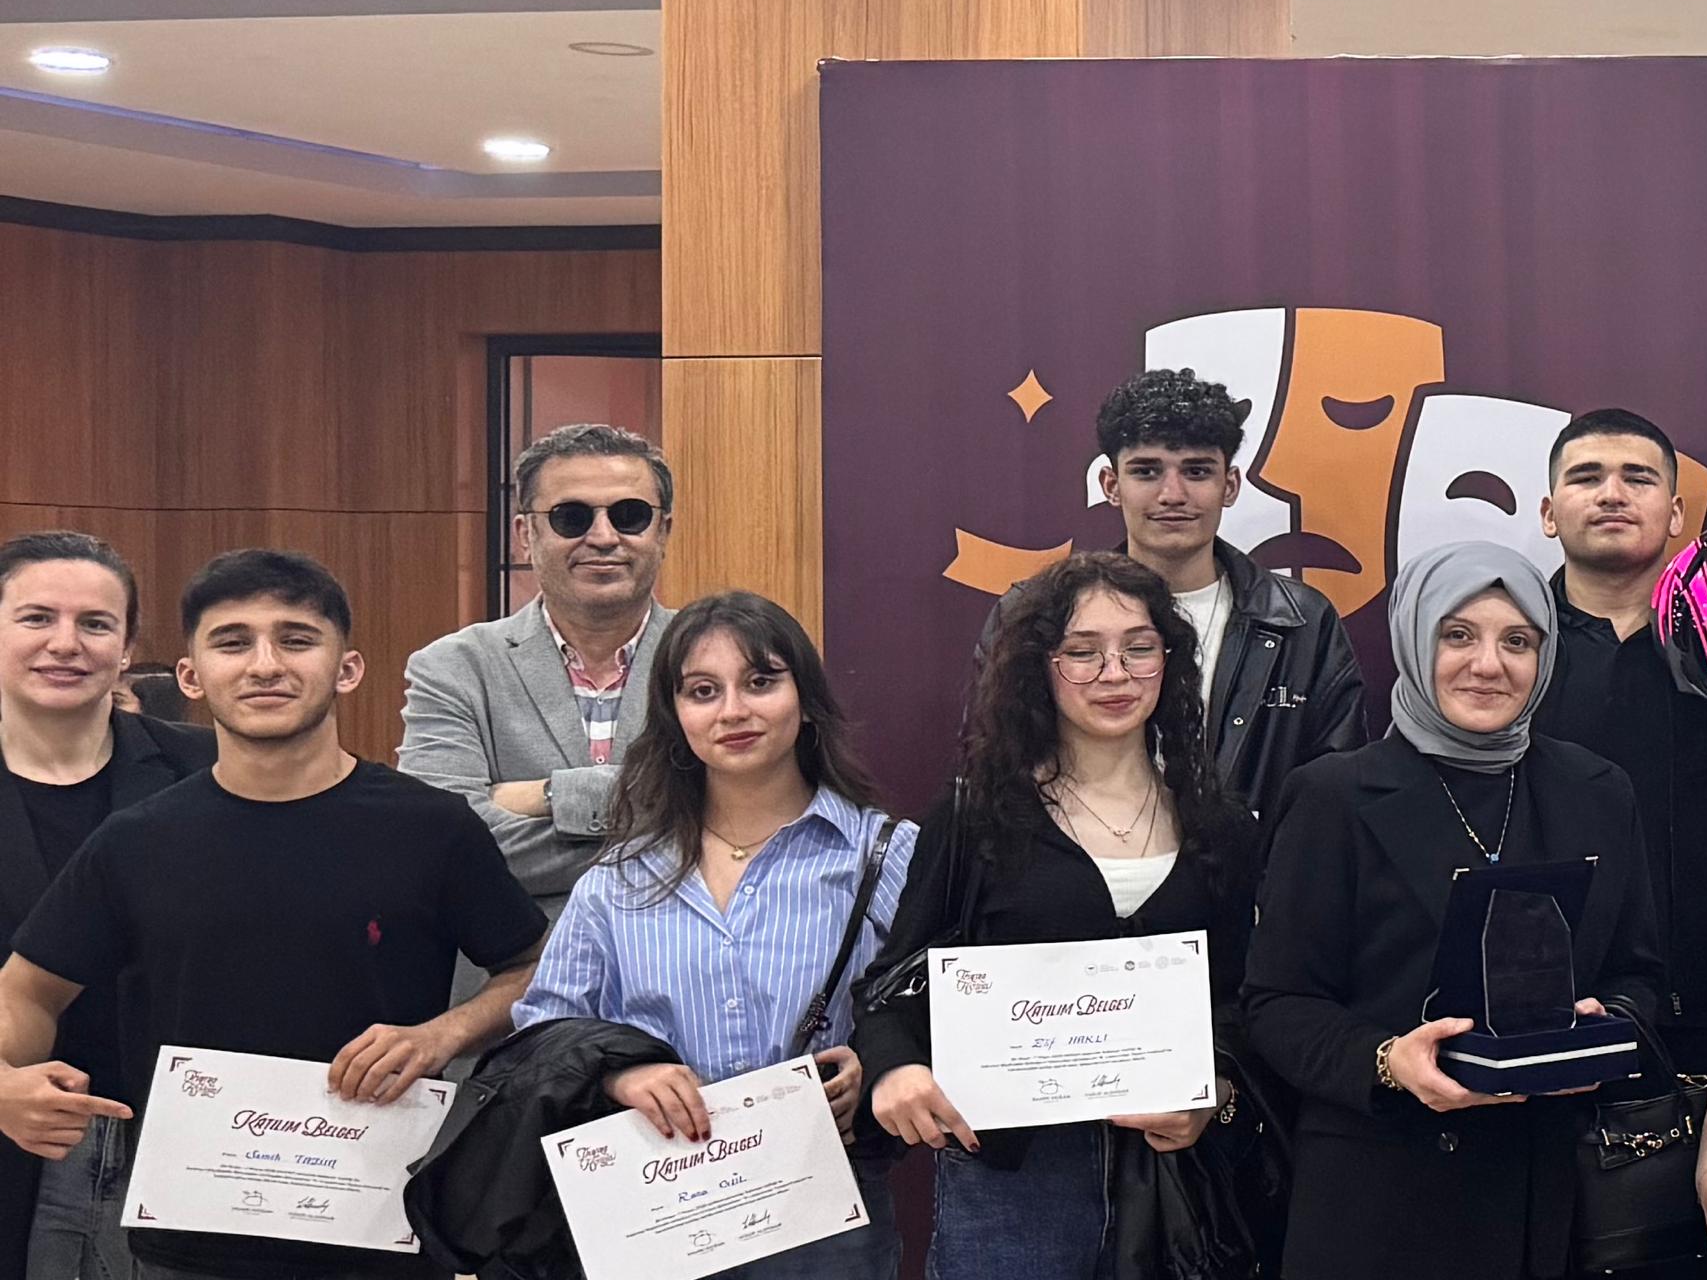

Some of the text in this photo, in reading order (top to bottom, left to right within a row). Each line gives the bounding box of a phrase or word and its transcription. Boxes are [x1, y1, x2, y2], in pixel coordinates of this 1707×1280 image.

[1011, 993, 1136, 1024] KATILIM BELGESİ
[231, 1109, 369, 1141] KATILIM BELGESİ
[643, 1152, 706, 1184] KATILIM
[706, 1129, 763, 1162] BELGESİ
